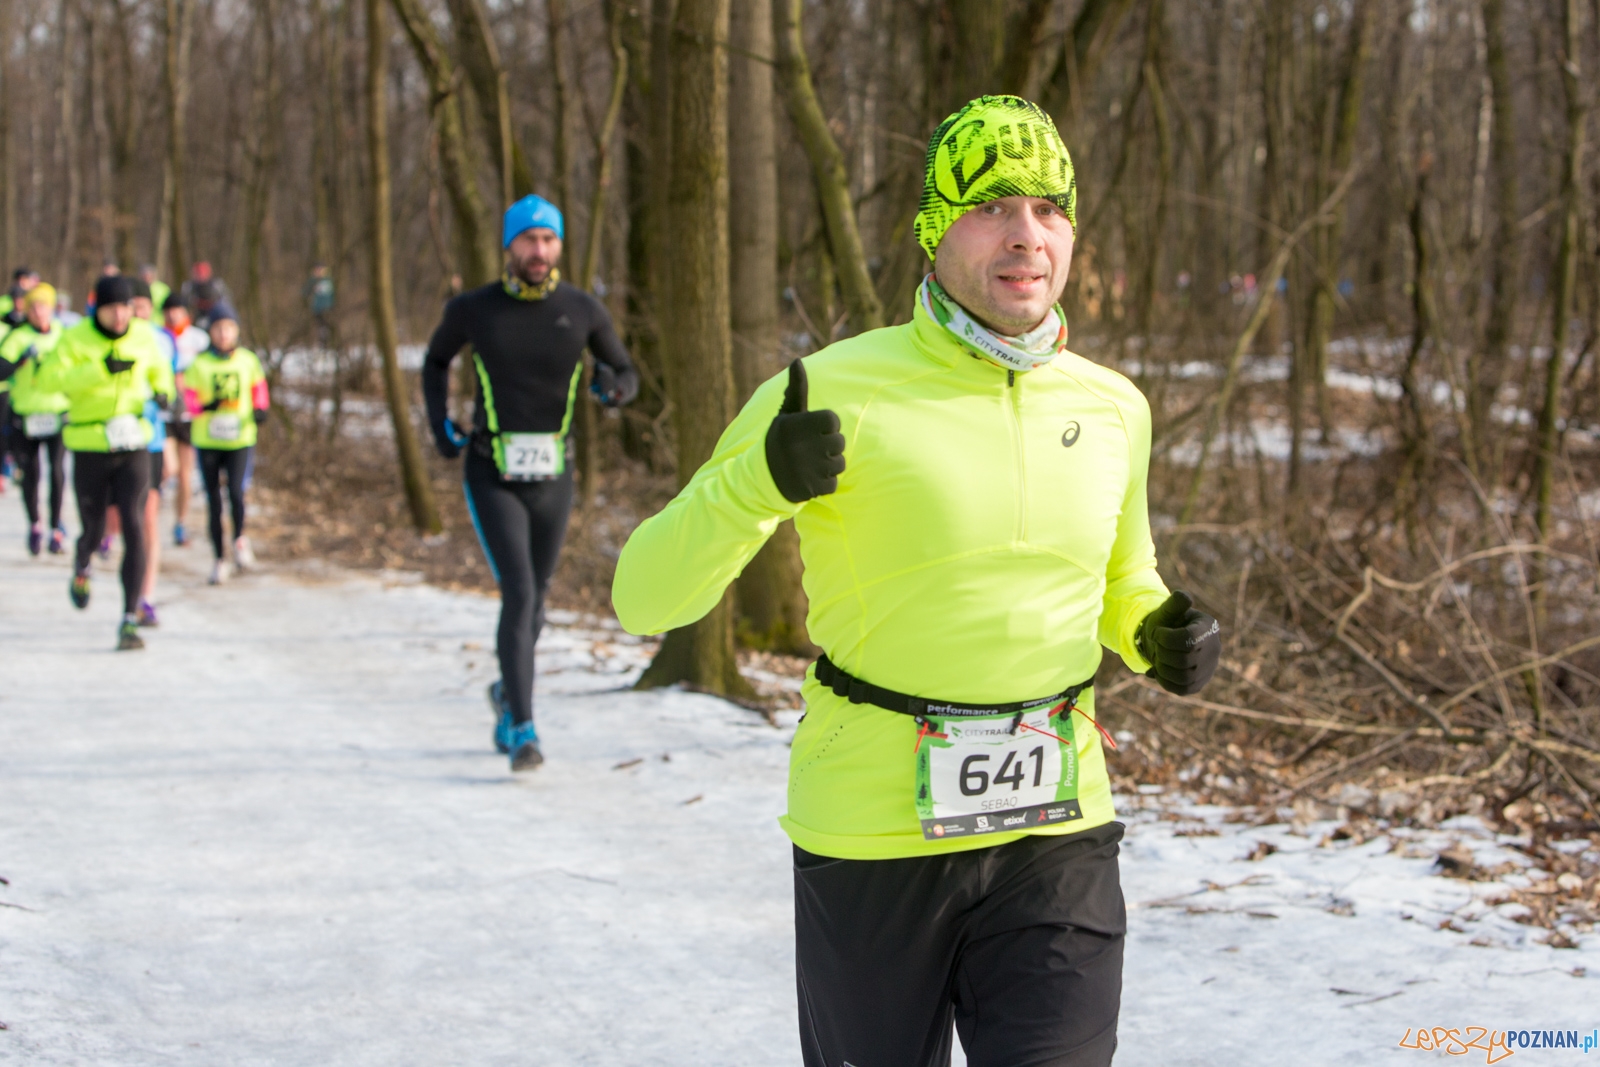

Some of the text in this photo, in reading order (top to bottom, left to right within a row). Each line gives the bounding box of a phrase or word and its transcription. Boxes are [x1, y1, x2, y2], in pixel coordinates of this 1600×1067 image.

[515, 447, 551, 466] 274
[926, 703, 999, 716] performance
[959, 745, 1044, 797] 641
[1064, 747, 1074, 787] Poznań
[981, 796, 1018, 811] SEBAQ
